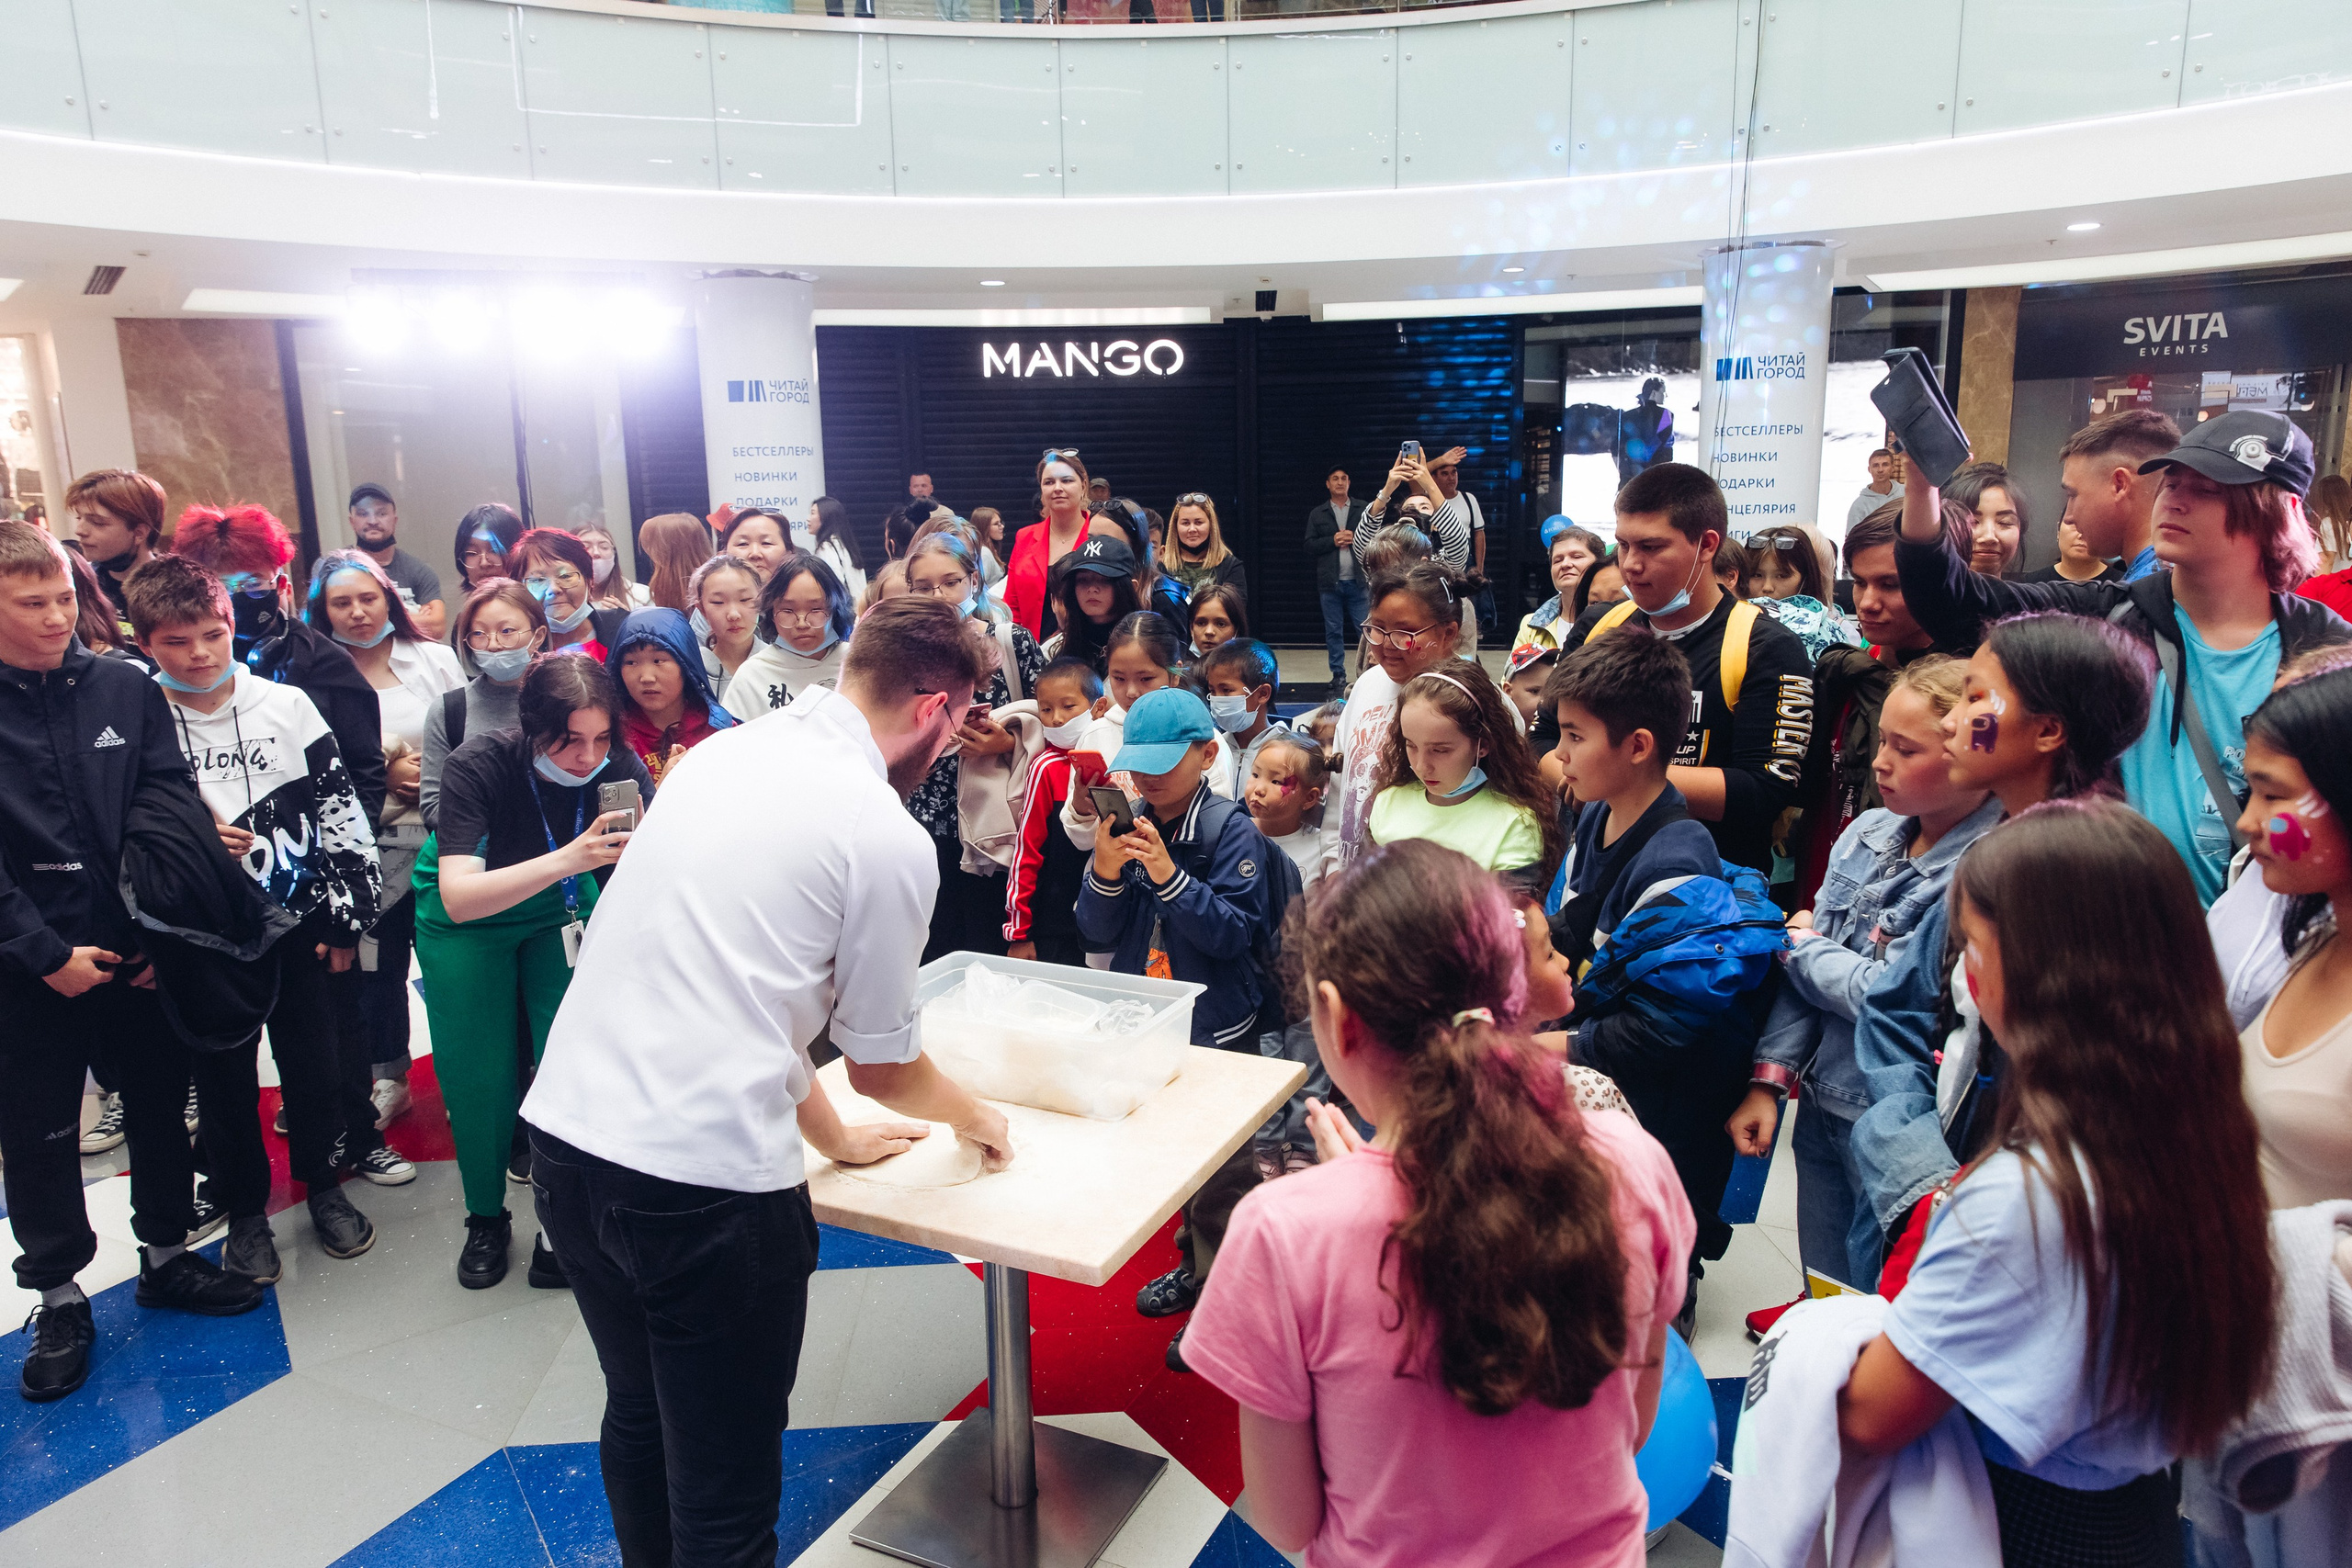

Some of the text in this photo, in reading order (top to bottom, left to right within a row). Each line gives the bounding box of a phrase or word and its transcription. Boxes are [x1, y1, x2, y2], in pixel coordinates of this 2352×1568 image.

[2123, 312, 2229, 344] SVITA
[2139, 344, 2209, 356] EVENTS
[982, 339, 1184, 378] MANGO
[1758, 352, 1805, 367] ЧИТАЙ
[1757, 367, 1805, 379] ГОРОД
[769, 378, 809, 391] ЧИТАЙ
[770, 391, 809, 404] ГОРОД
[1714, 424, 1804, 437] БЕСТСЕЛЛЕРЫ
[732, 446, 814, 457] БЕСТСЕЛЛЕРЫ
[1713, 452, 1778, 463] НОВИНКИ
[735, 472, 797, 482] НОВИНКИ
[736, 497, 798, 507] ПОДАРКИ
[1726, 503, 1796, 515] НЦЕЛЯРИЯ
[1772, 673, 1815, 760] MASTER
[94, 738, 127, 749] adidas
[574, 807, 584, 834] Colliers
[49, 862, 84, 872] adidas
